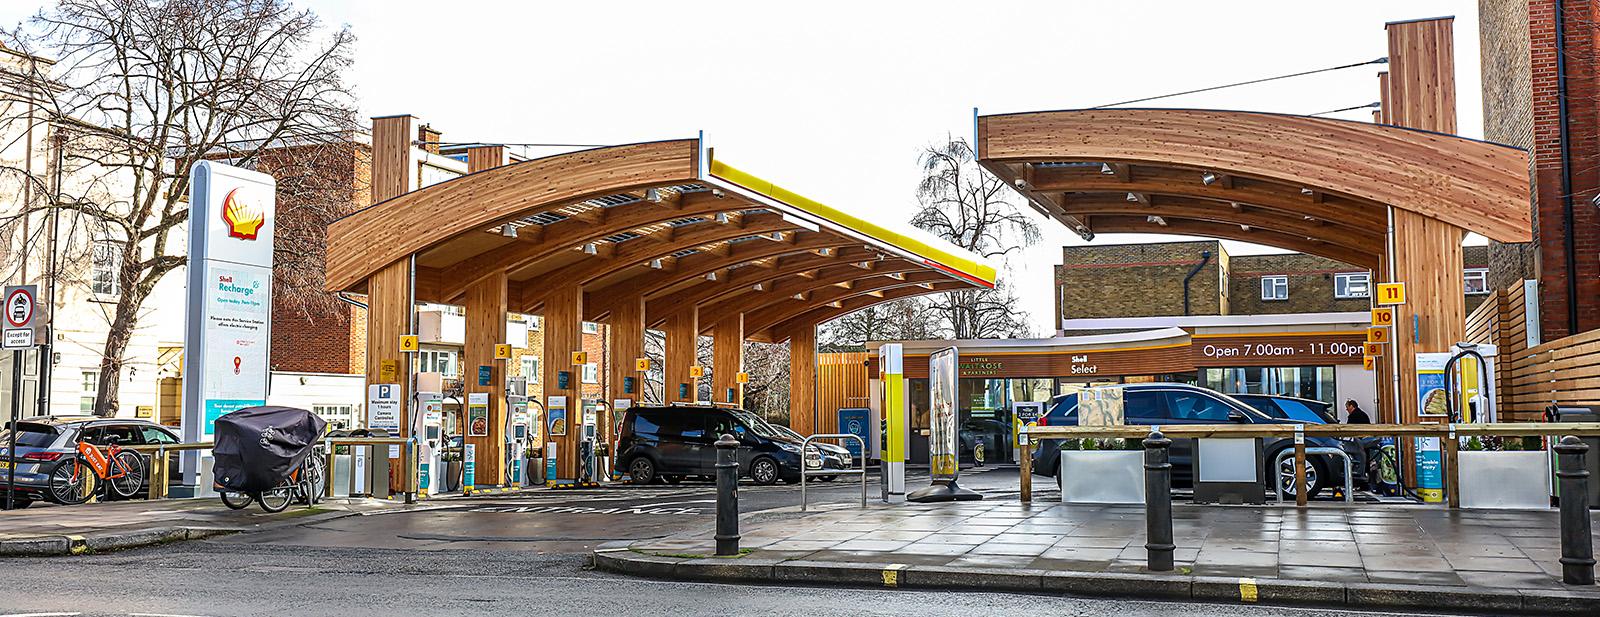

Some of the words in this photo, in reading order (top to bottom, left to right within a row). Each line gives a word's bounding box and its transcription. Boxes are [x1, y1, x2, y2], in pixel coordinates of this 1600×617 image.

[219, 283, 254, 296] Recharge
[1386, 287, 1398, 299] 11
[1377, 312, 1391, 322] 10
[1374, 331, 1382, 340] 9
[404, 338, 411, 348] 6
[499, 347, 505, 355] 5
[1203, 344, 1239, 359] Open
[1243, 343, 1294, 356] 7.00am
[1370, 345, 1376, 353] 8
[575, 354, 581, 362] 4
[1071, 355, 1088, 363] Shell
[1366, 359, 1373, 368] 7
[1071, 364, 1097, 374] Select
[381, 386, 389, 398] P
